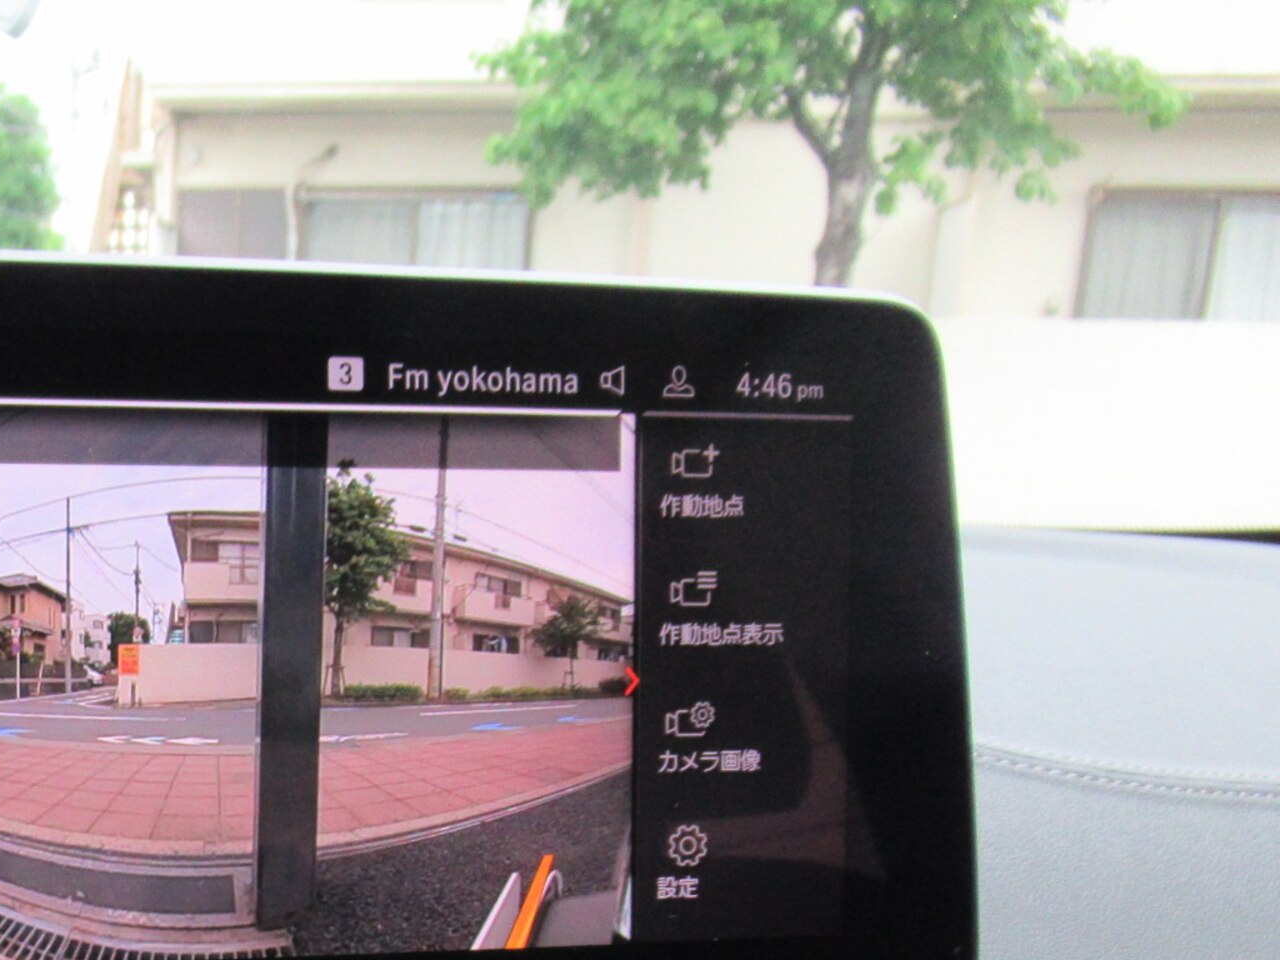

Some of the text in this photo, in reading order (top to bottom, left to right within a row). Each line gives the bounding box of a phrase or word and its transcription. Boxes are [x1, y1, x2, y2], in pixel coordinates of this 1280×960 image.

[339, 361, 353, 386] 3
[387, 362, 579, 398] Fm yokohama
[735, 371, 825, 403] 4:46 pm
[659, 493, 745, 518] 作動地点
[658, 622, 785, 647] 作動地点表示
[657, 749, 762, 773] カメラ画像
[656, 876, 700, 901] 設定
